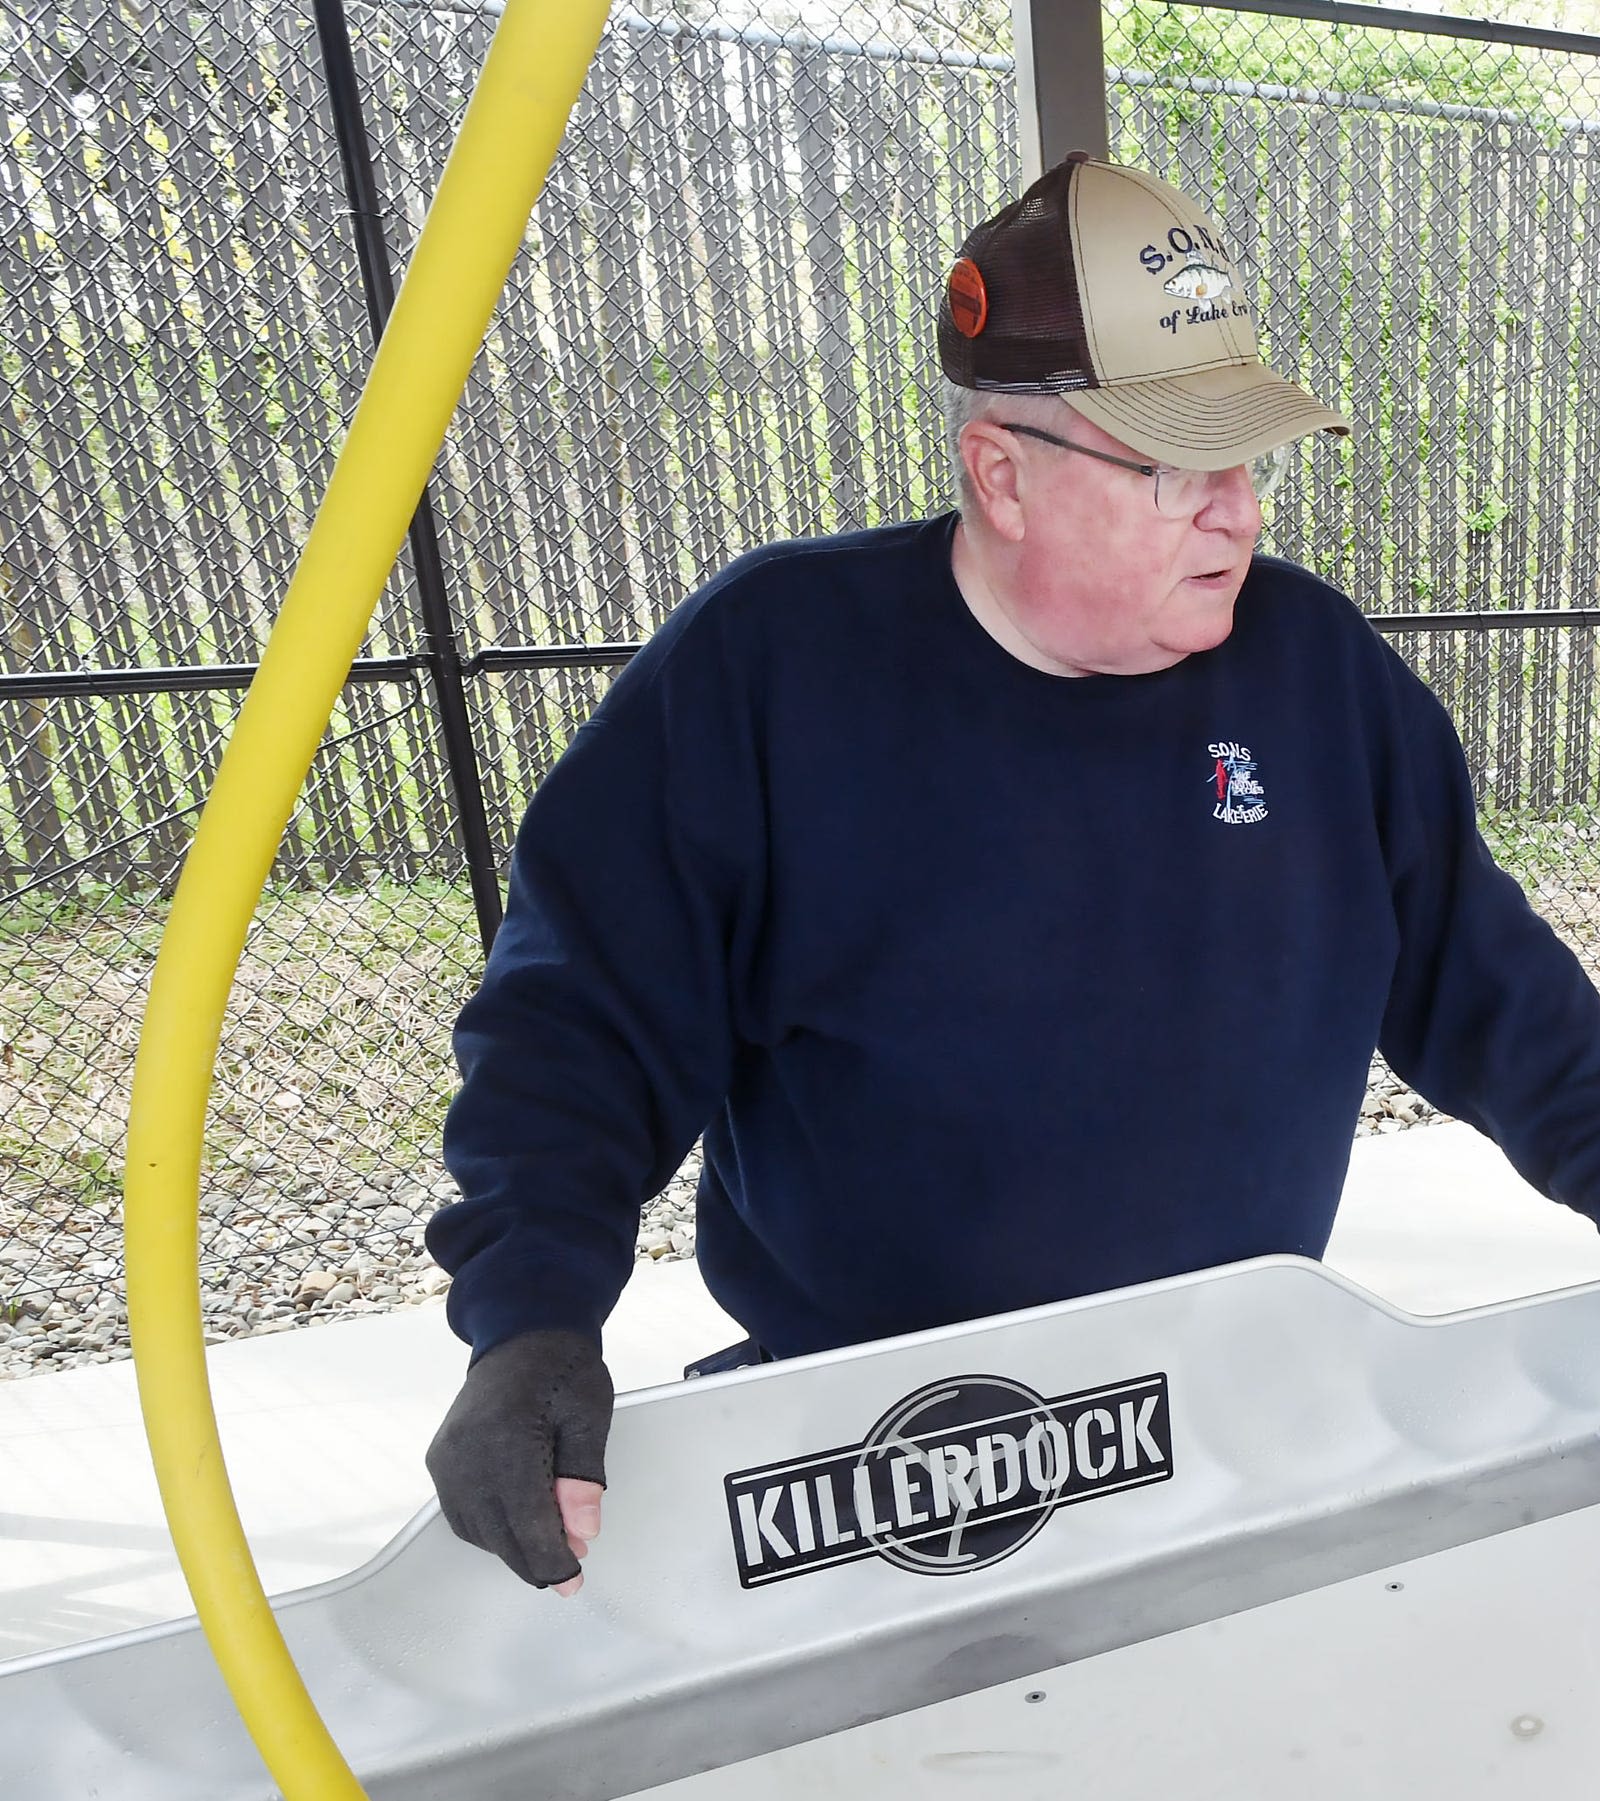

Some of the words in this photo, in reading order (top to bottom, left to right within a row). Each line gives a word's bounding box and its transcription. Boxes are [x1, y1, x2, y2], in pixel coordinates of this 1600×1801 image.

[1159, 309, 1181, 334] of
[1186, 304, 1229, 325] Lake
[1212, 802, 1242, 824] LAKE
[1242, 804, 1269, 824] ERIE
[736, 1395, 1166, 1567] KILLERDOCK
